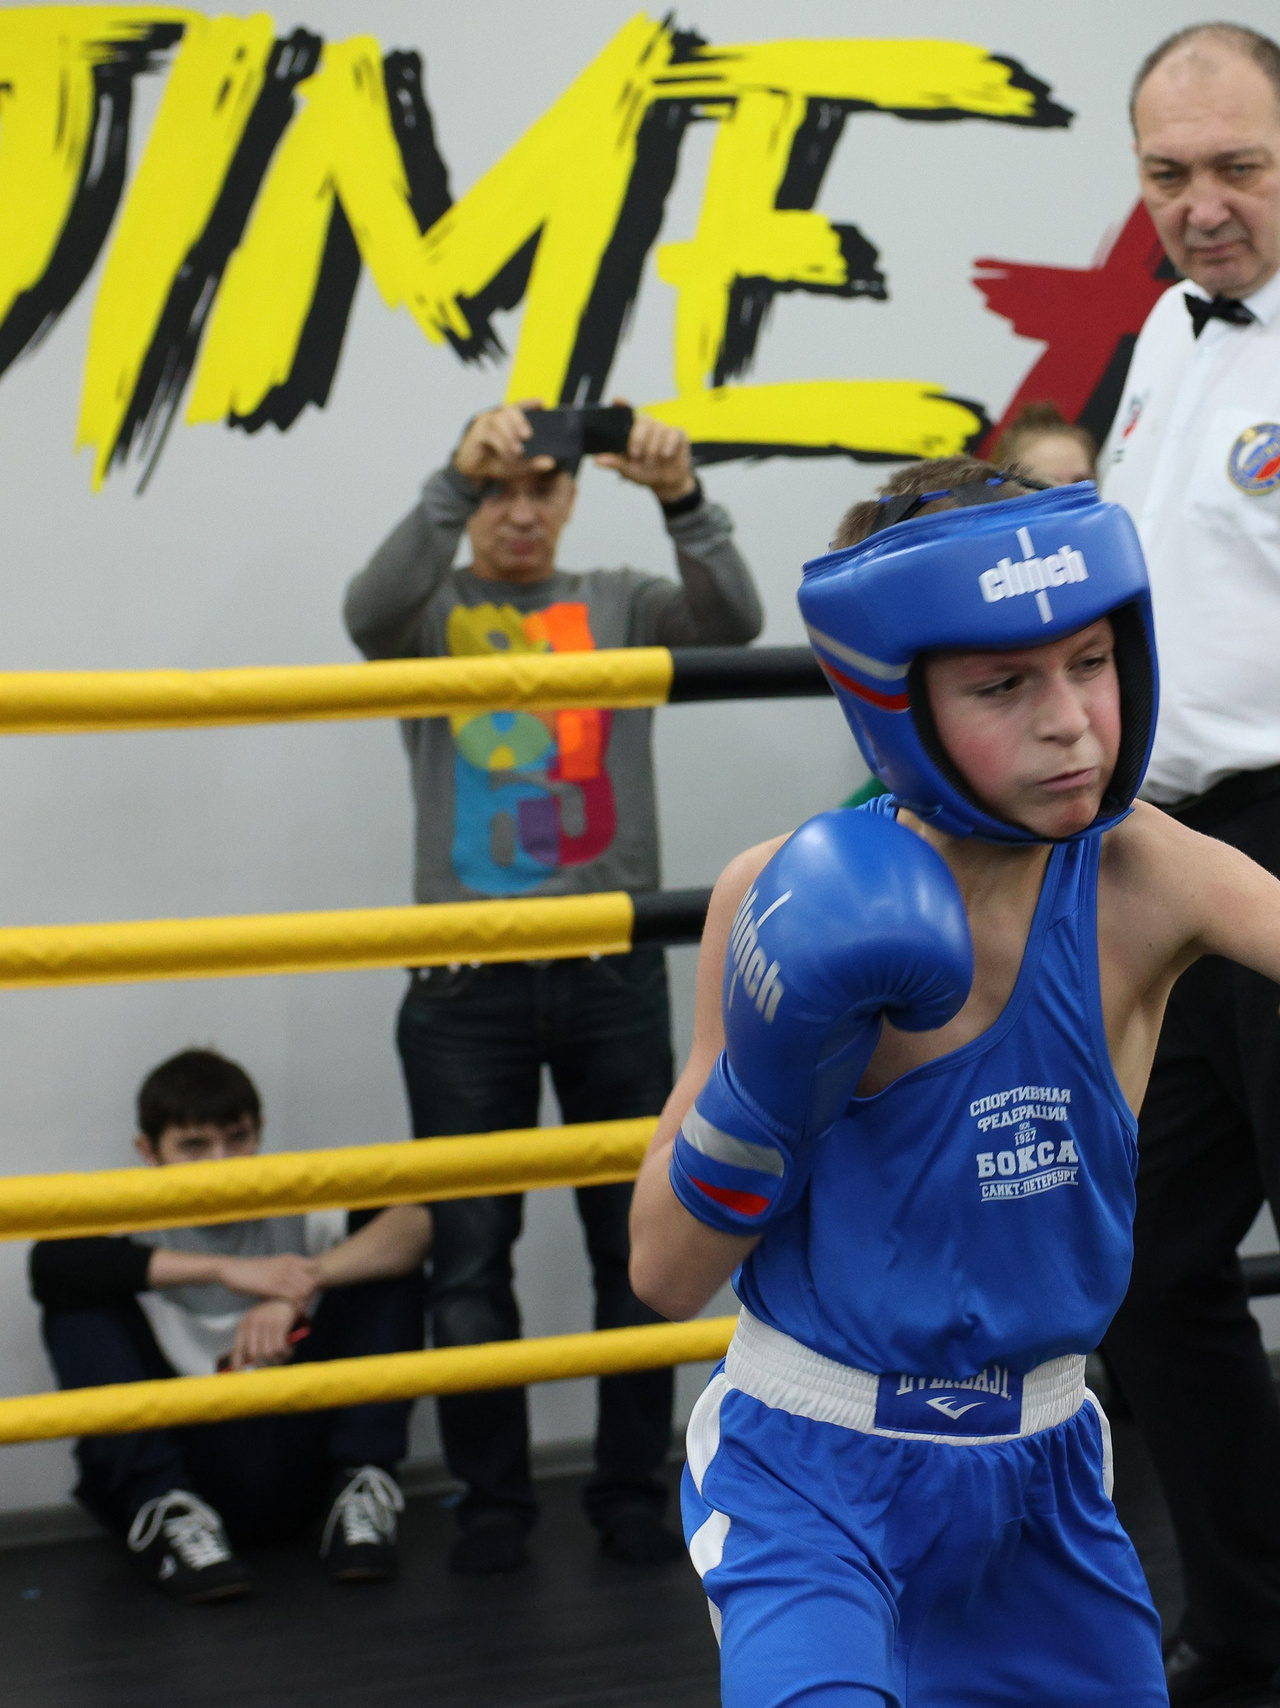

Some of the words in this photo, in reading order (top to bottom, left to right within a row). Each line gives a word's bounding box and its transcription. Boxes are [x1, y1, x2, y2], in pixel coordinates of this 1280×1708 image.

[969, 1085, 1071, 1118] СПОРТИВНАЯ
[977, 1104, 1068, 1133] ФЕДЕРАЦИЯ
[1014, 1129, 1037, 1146] 1927
[976, 1139, 1079, 1178] БОКСА
[981, 1169, 1078, 1198] САНКТ-ПЕТЕРБУРГ
